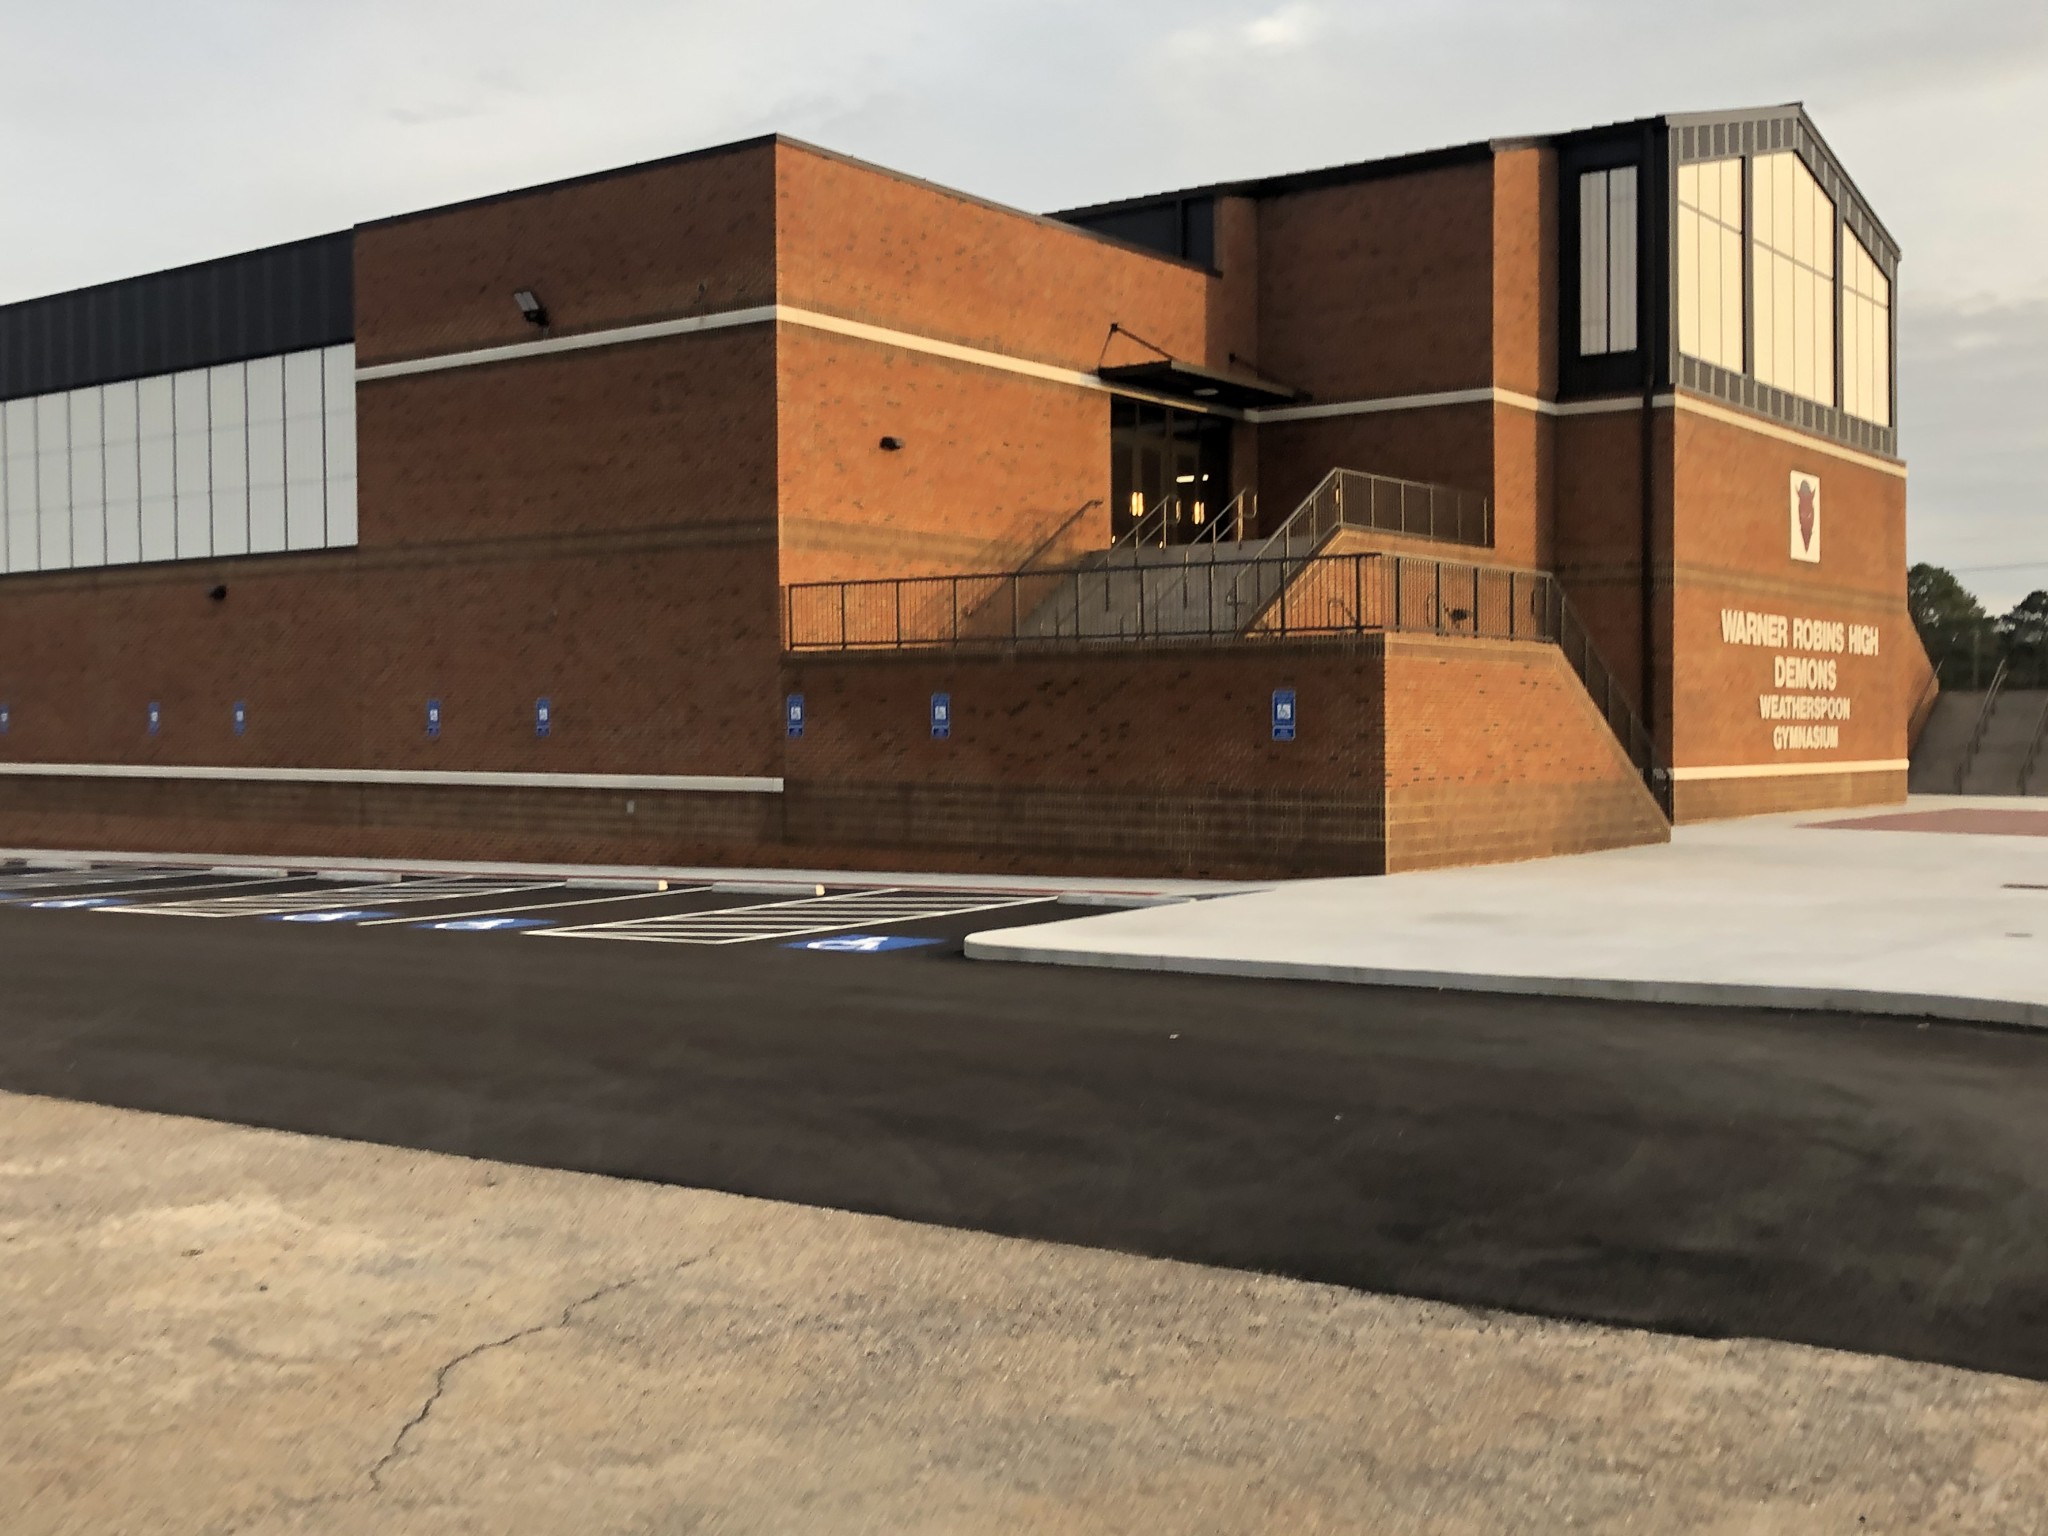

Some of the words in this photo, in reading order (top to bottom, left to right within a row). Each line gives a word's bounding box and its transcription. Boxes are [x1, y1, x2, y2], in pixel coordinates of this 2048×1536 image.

[1721, 608, 1788, 648] WARNER
[1792, 617, 1844, 654] ROBINS
[1848, 624, 1879, 656] HIGH
[1774, 655, 1837, 691] DEMONS
[1759, 694, 1851, 720] WEATHERSPOON
[1773, 725, 1839, 750] GYMNASIUM
